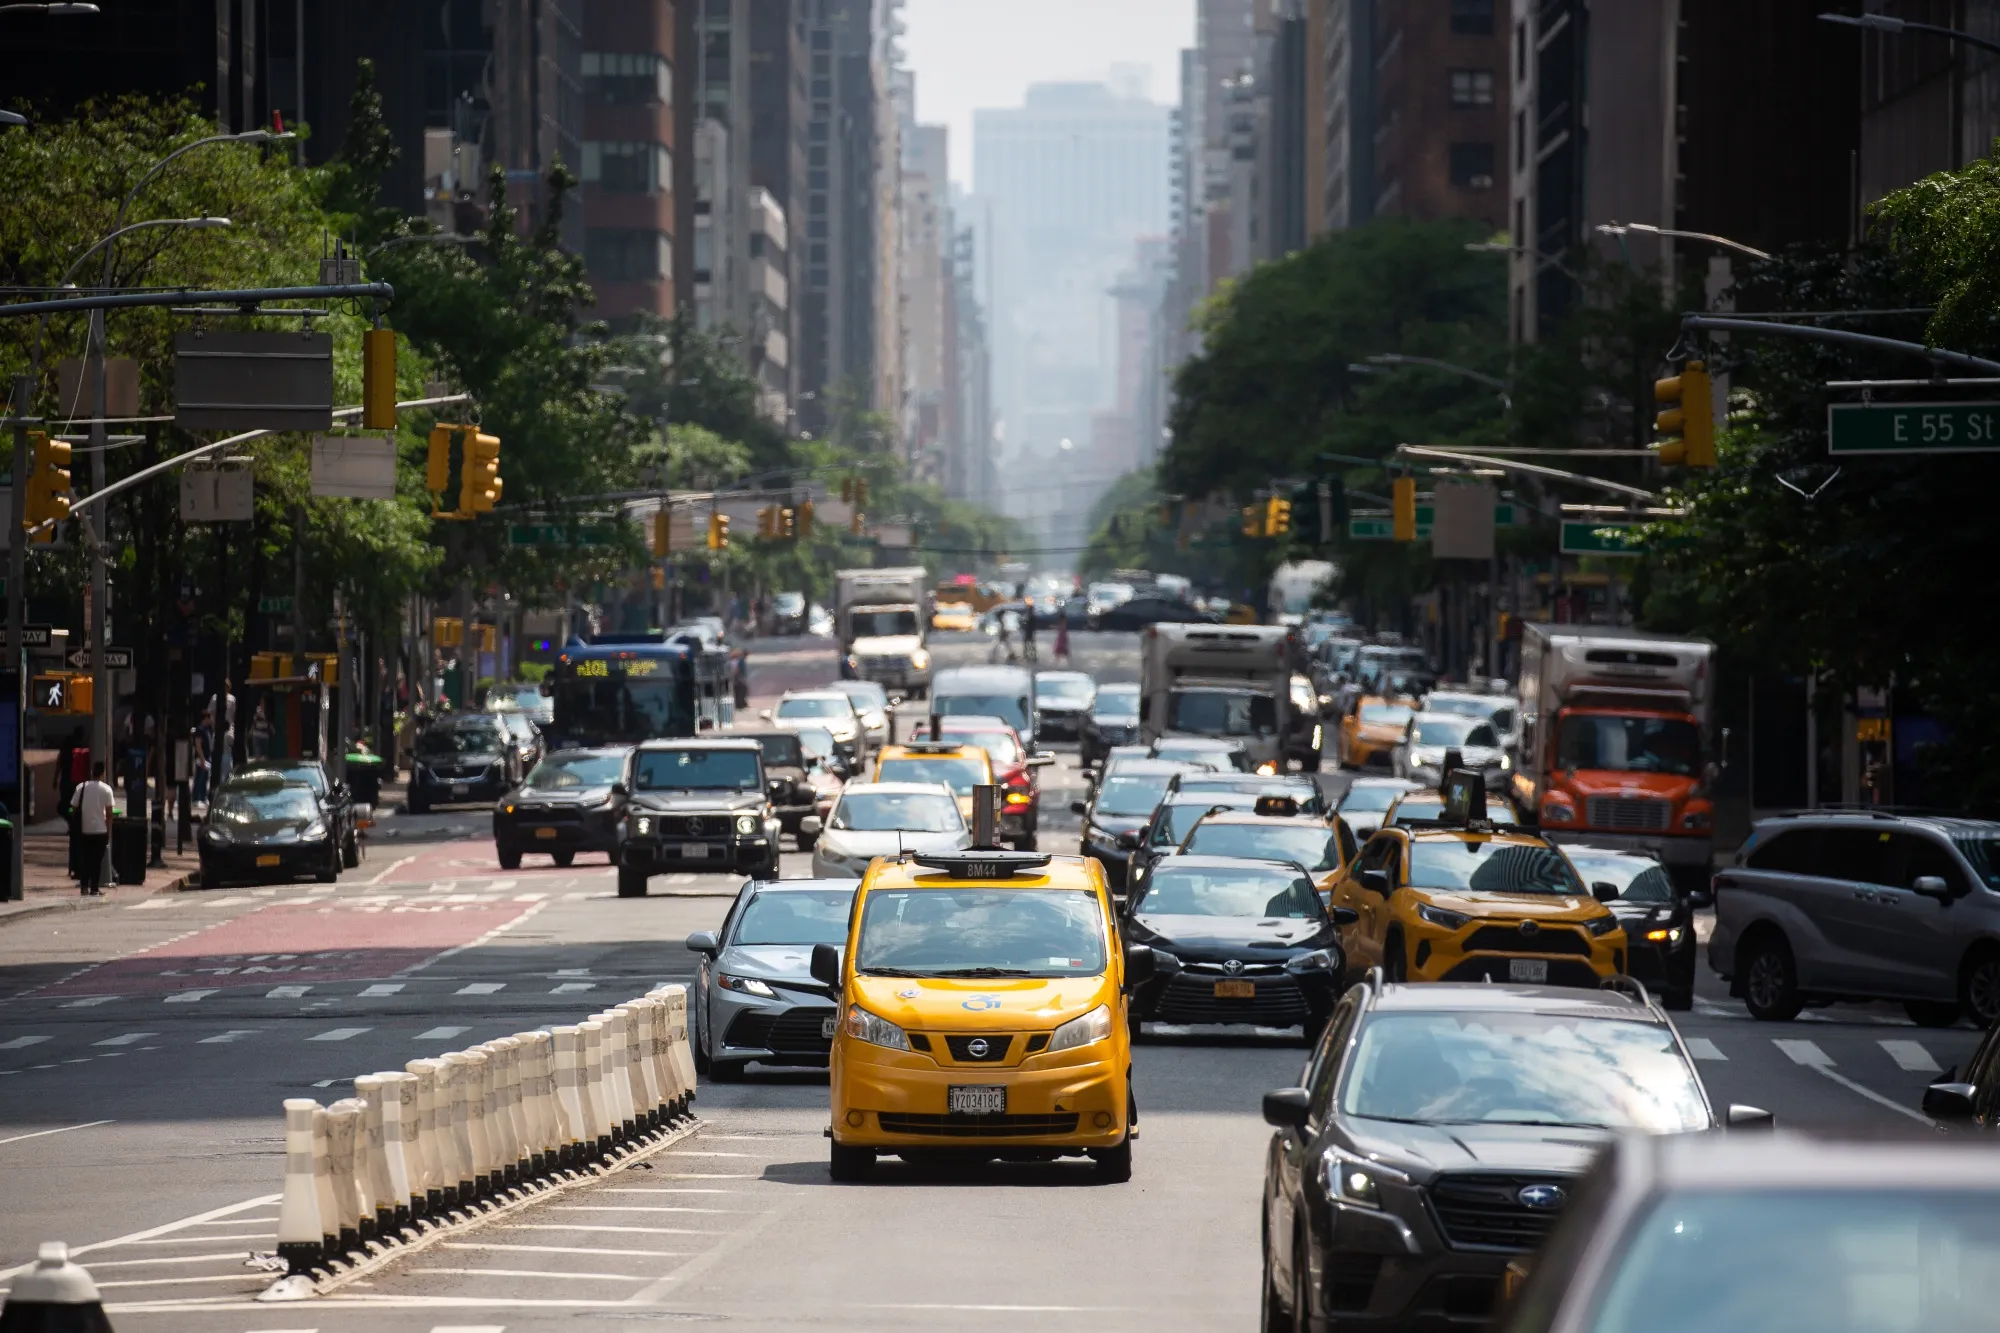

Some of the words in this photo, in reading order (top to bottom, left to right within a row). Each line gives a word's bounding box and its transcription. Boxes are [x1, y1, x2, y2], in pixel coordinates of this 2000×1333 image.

[1894, 414, 1908, 441] E
[1922, 414, 1954, 441] 55
[1967, 413, 1994, 440] St
[967, 863, 996, 877] 8M44
[955, 1093, 999, 1108] Y203418C
